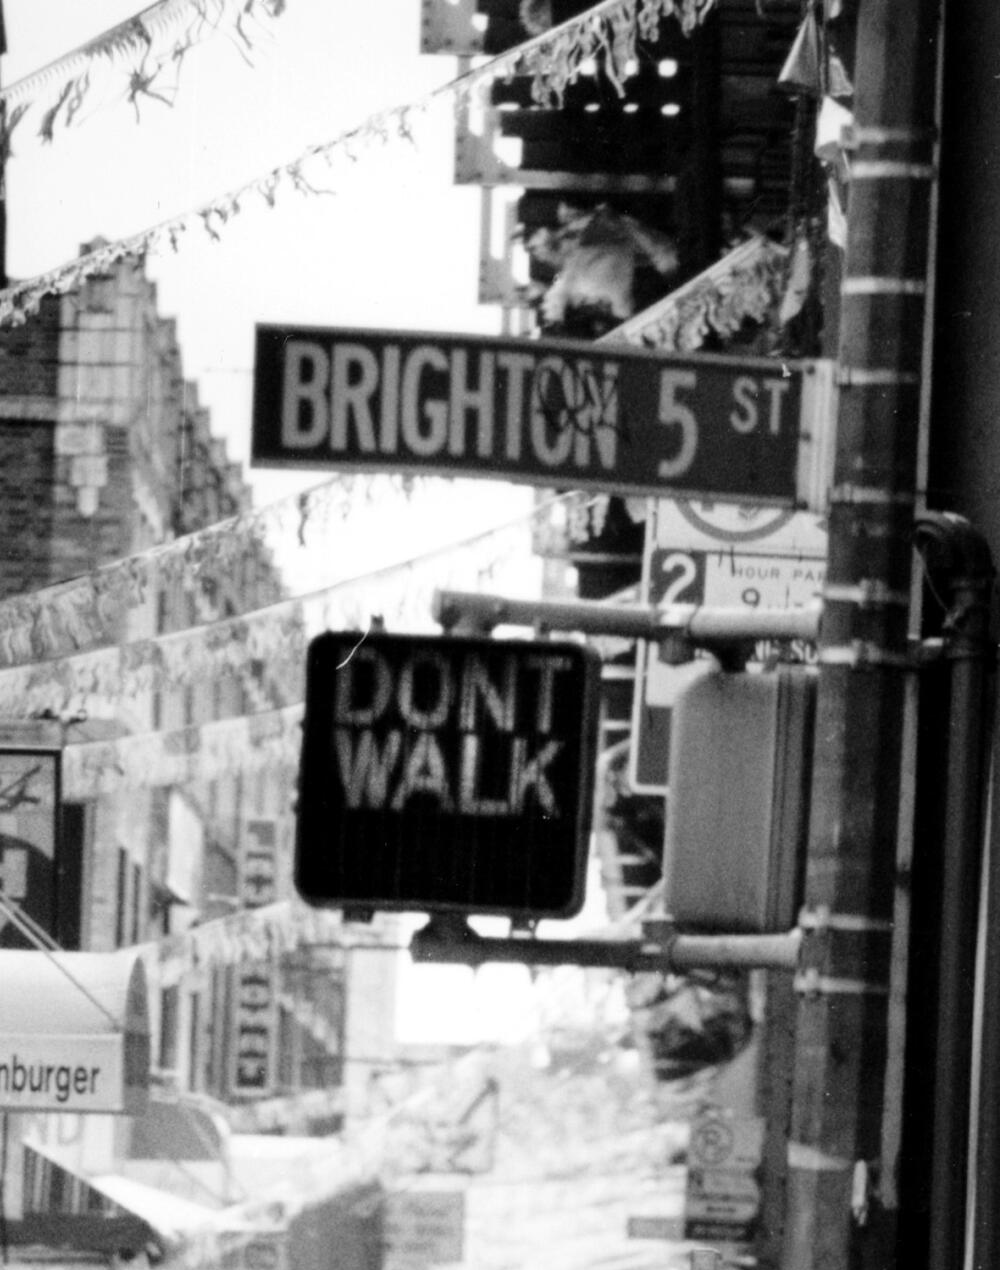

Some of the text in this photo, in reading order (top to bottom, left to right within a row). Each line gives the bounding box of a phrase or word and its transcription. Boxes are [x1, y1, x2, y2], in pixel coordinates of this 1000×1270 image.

[280, 340, 620, 470] BRIGHTON
[657, 368, 699, 478] 5
[729, 375, 790, 436] ST
[661, 552, 697, 606] 2
[334, 646, 573, 734] DONT
[334, 728, 564, 818] WALK
